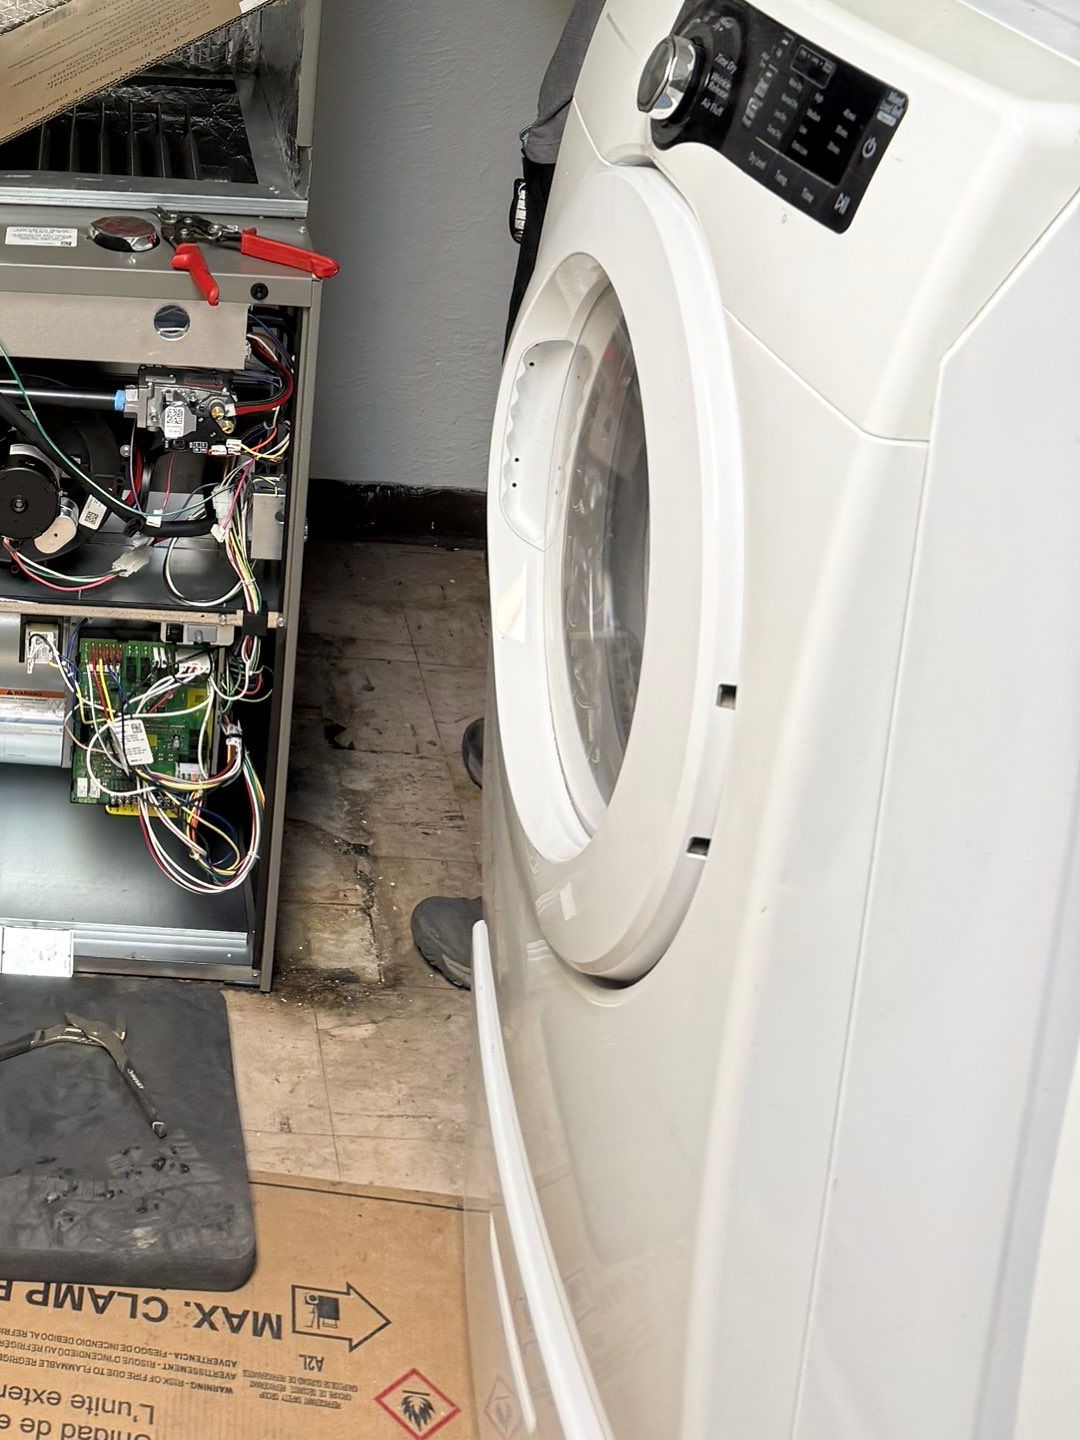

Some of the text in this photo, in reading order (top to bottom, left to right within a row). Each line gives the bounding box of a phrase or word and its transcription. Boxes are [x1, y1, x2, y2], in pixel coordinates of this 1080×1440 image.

[25, 1282, 168, 1323] CLAMP
[184, 1301, 282, 1340] MAX.
[29, 1329, 40, 1339] AL
[41, 1331, 74, 1344] DEBIDO
[76, 1336, 119, 1350] INCENDIO
[120, 1342, 133, 1352] DE
[44, 1345, 57, 1355] AU
[122, 1356, 156, 1369] RISQUE
[174, 1350, 237, 1367] ADVERTENCIA
[298, 1355, 324, 1372] A2L
[38, 1359, 91, 1374] FLAMMABLE
[93, 1366, 105, 1376] TO
[162, 1362, 237, 1380] AVERTISSEMENT
[106, 1368, 125, 1379] DUE
[126, 1371, 148, 1382] FIRE
[149, 1374, 162, 1384] OF
[163, 1376, 184, 1388] RISK
[190, 1380, 233, 1395] WARNING
[70, 1394, 154, 1425] L'unite
[20, 1417, 52, 1439] de
